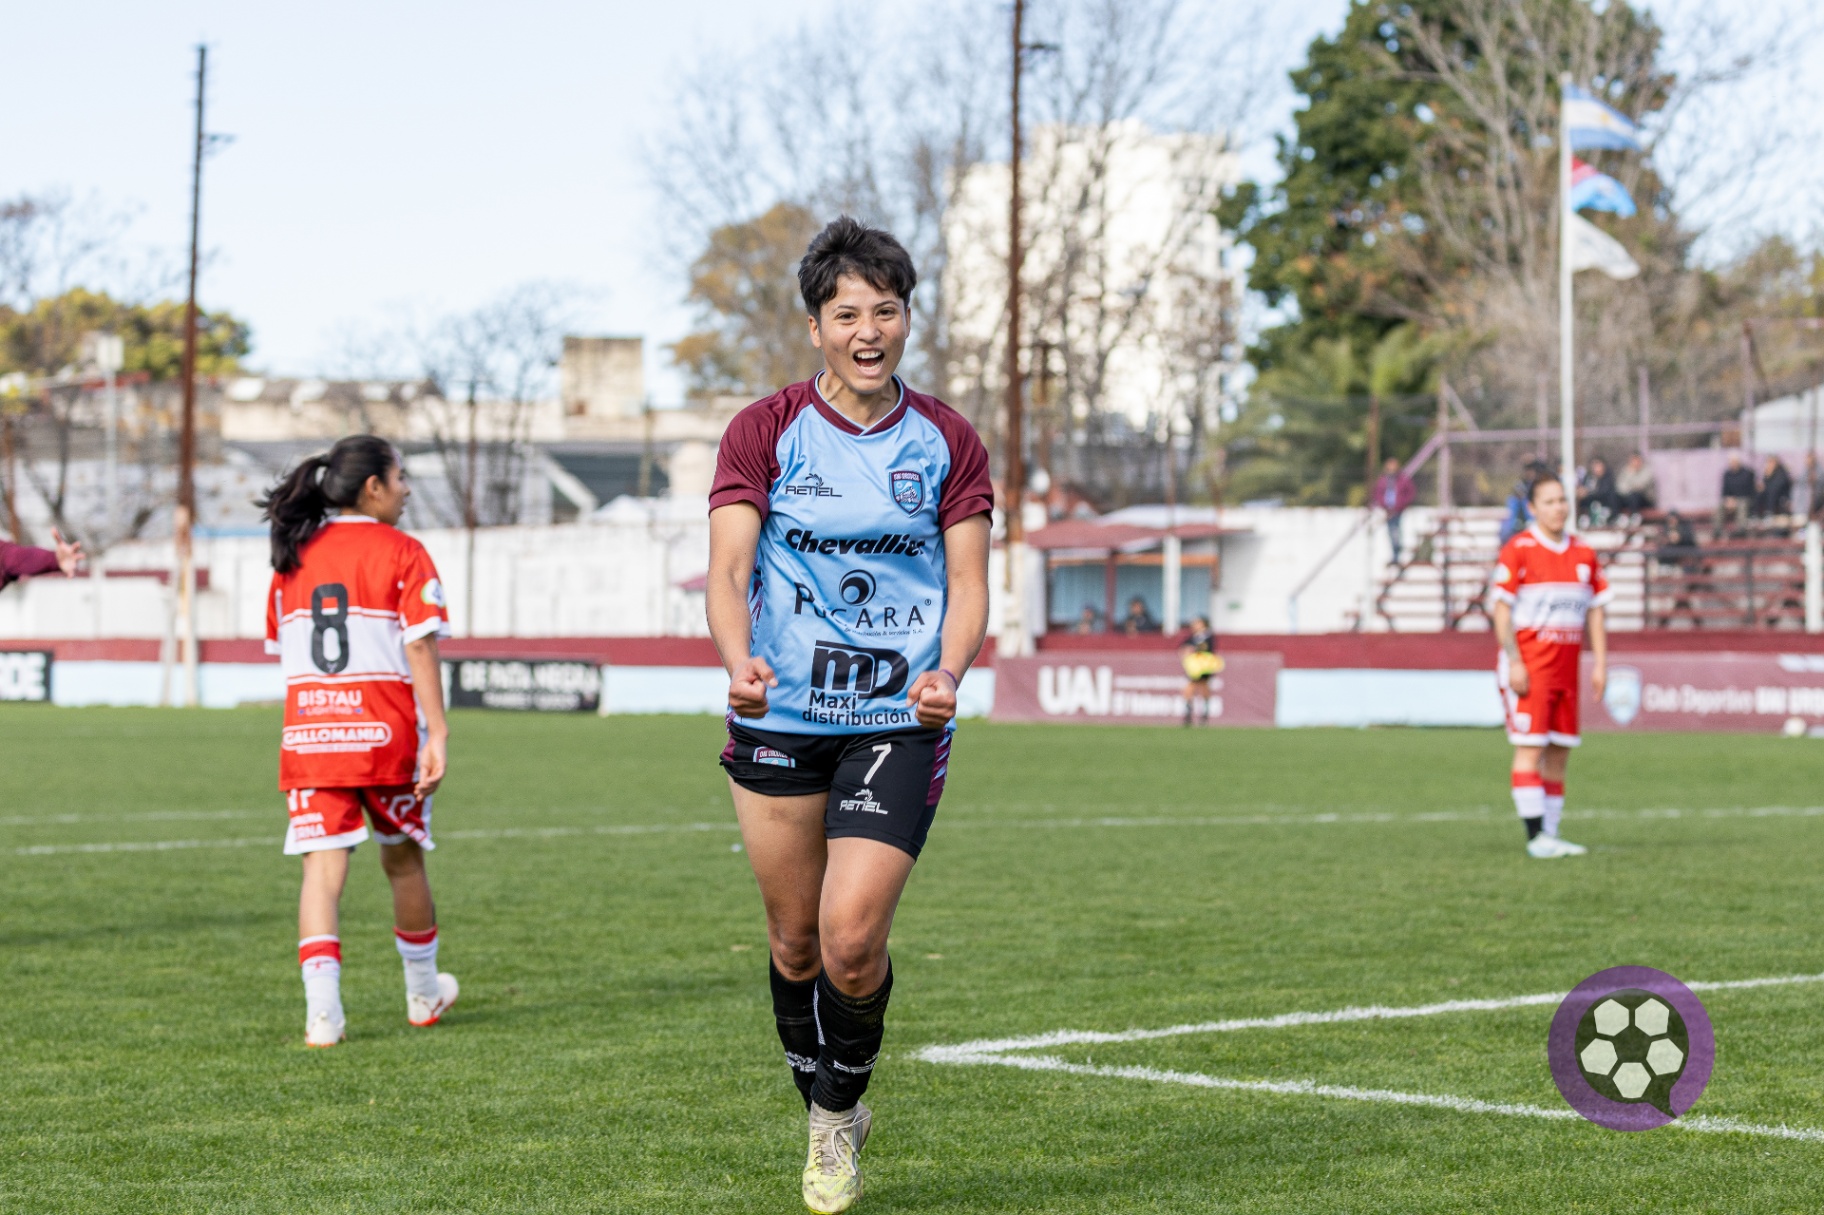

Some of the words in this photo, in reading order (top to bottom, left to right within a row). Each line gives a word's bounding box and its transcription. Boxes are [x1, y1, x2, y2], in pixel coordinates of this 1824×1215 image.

[311, 583, 349, 674] 8
[297, 688, 363, 707] BISTAU
[809, 689, 857, 710] Maxi
[1037, 665, 1113, 716] UAI
[802, 708, 912, 726] distribución
[863, 742, 892, 785] 7
